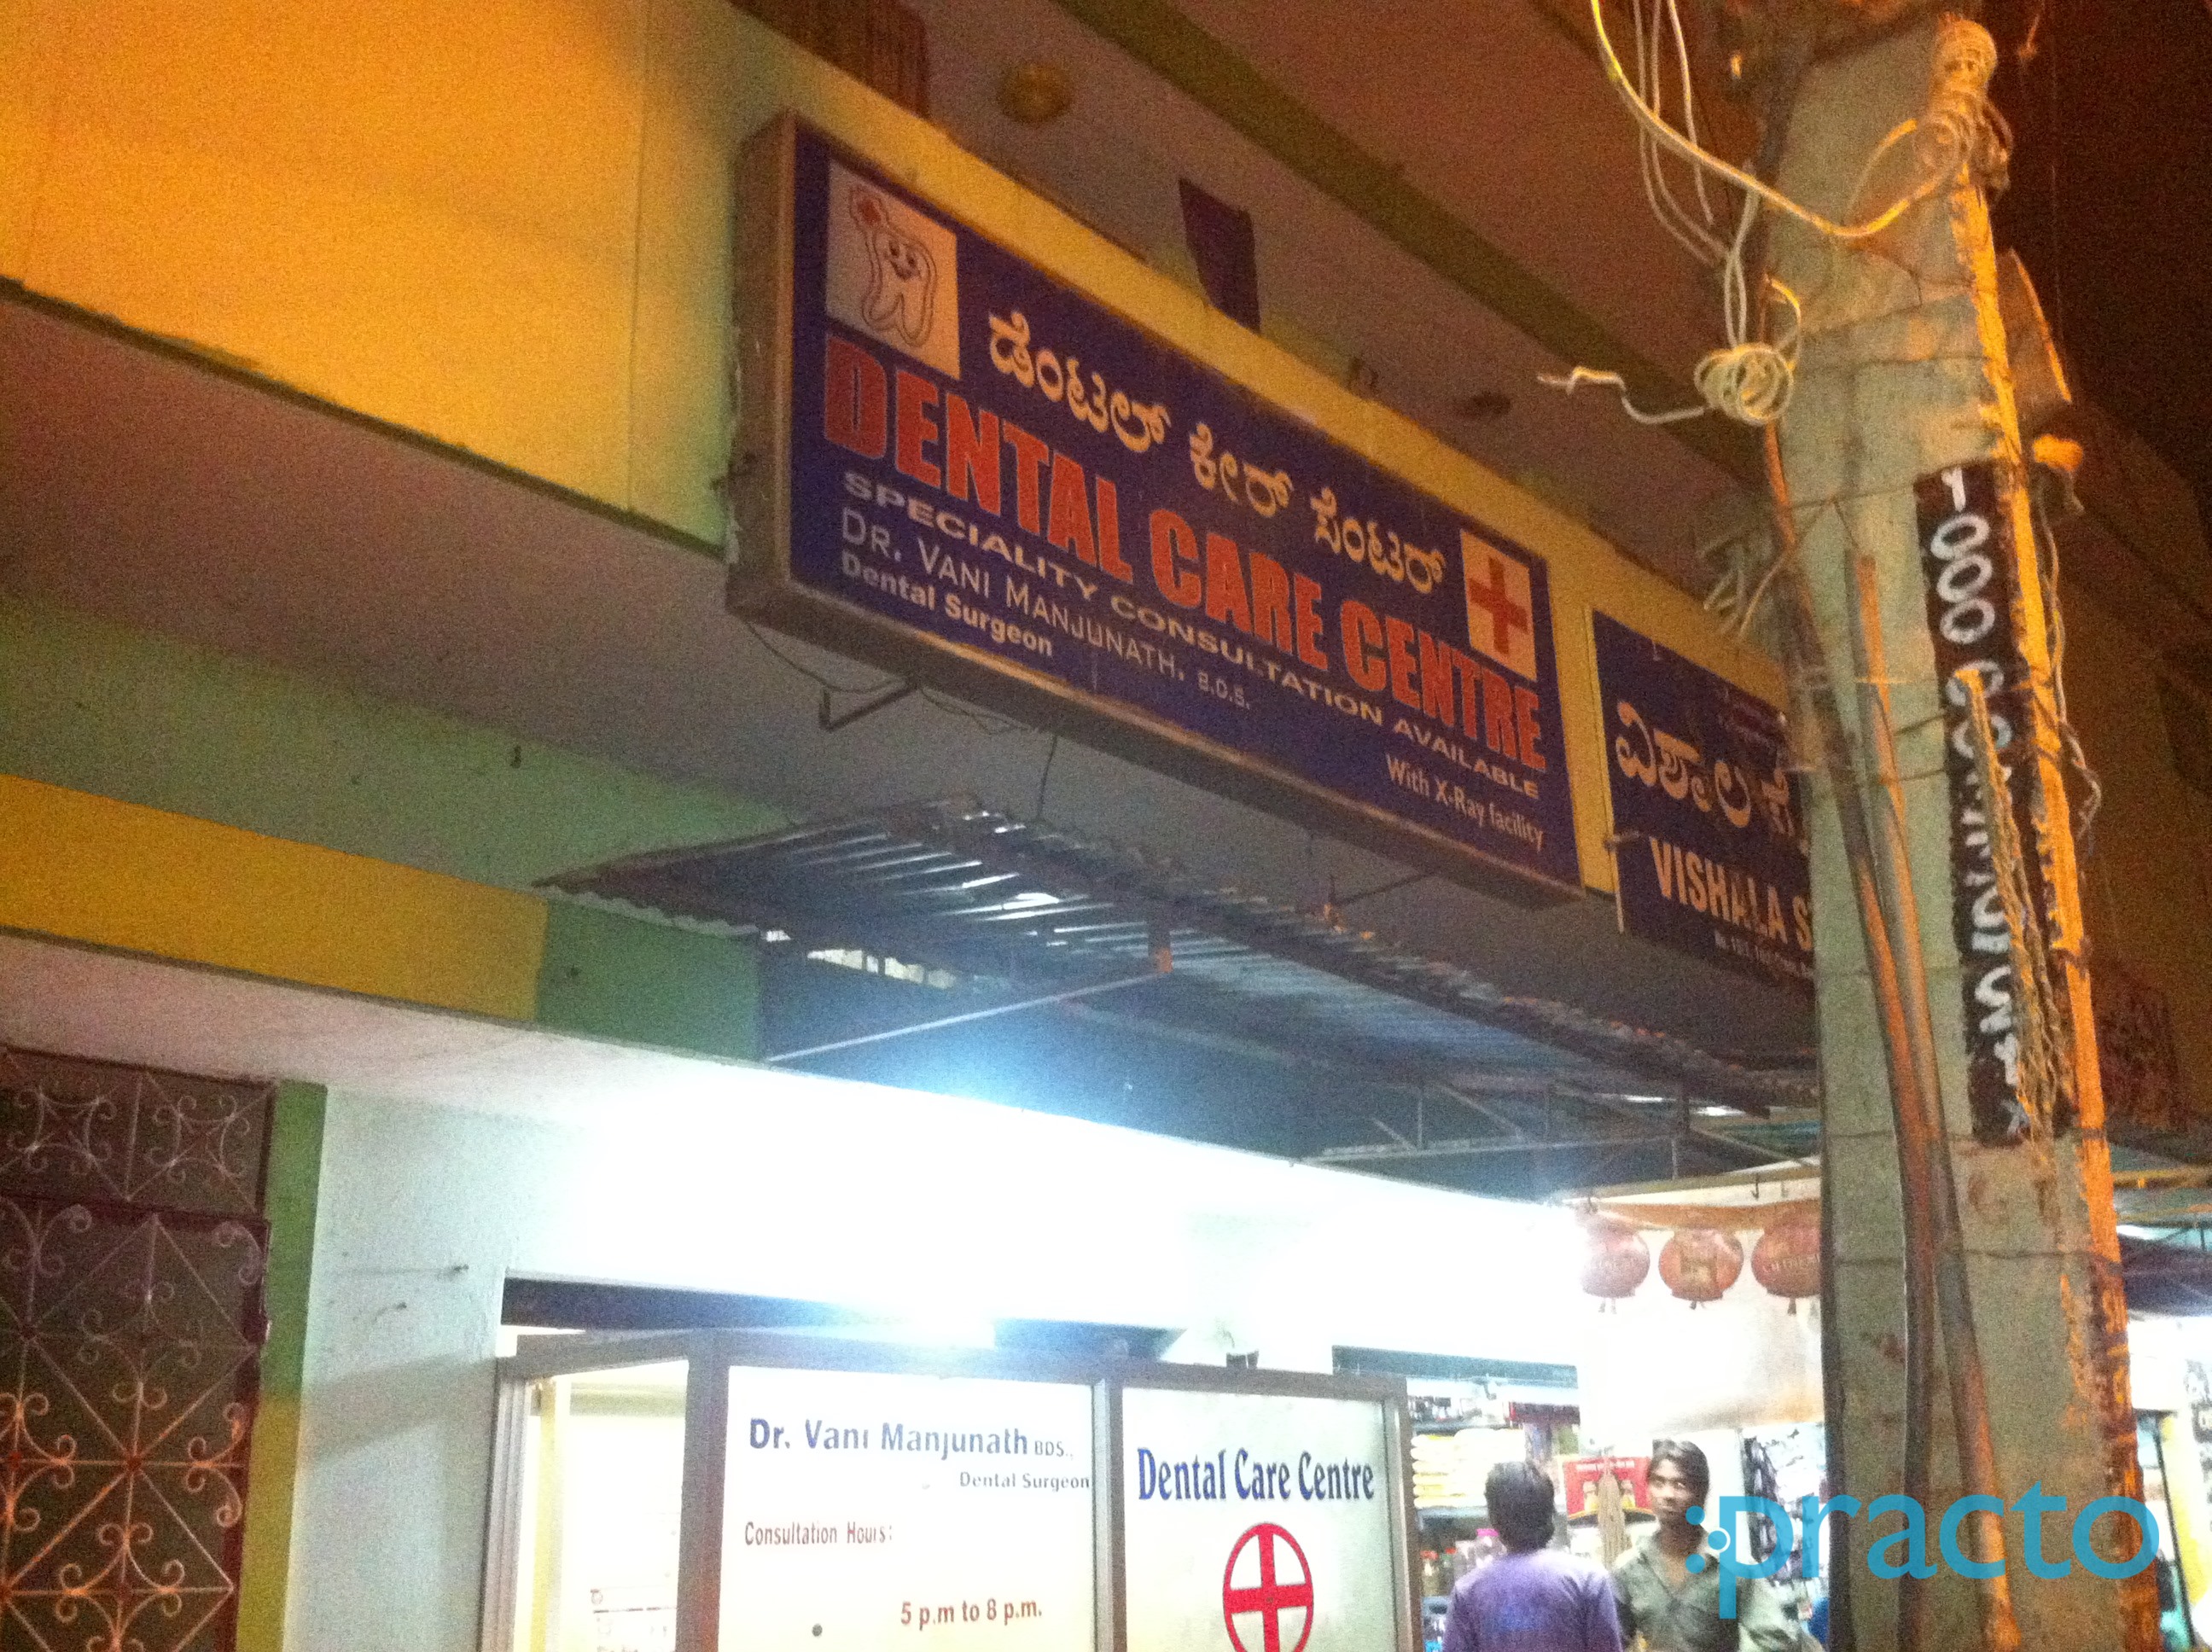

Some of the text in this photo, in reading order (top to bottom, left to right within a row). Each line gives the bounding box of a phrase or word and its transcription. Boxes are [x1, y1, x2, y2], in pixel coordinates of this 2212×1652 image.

[824, 334, 1546, 773] DENTAL CARE CENTRE
[842, 507, 903, 561] DR.
[917, 538, 990, 597] VANI
[841, 550, 1054, 657] Dental Surgeon
[844, 471, 1540, 800] SPECIALITY CONSULTATION AVAILABLE
[1385, 753, 1430, 799] With
[1488, 802, 1544, 852] facility
[1649, 835, 1789, 945] VISHALA
[749, 1417, 790, 1449] Dr.
[805, 1418, 869, 1450] Vani
[881, 1422, 1028, 1461] Manjunath
[959, 1471, 1090, 1492] Dental Surgeon
[1138, 1447, 1376, 1500] Dental Care Centre
[744, 1521, 838, 1545] Consultation
[900, 1600, 912, 1626] 5
[962, 1600, 980, 1622] to
[987, 1597, 998, 1621] 8
[1004, 1600, 1043, 1626] p.m.
